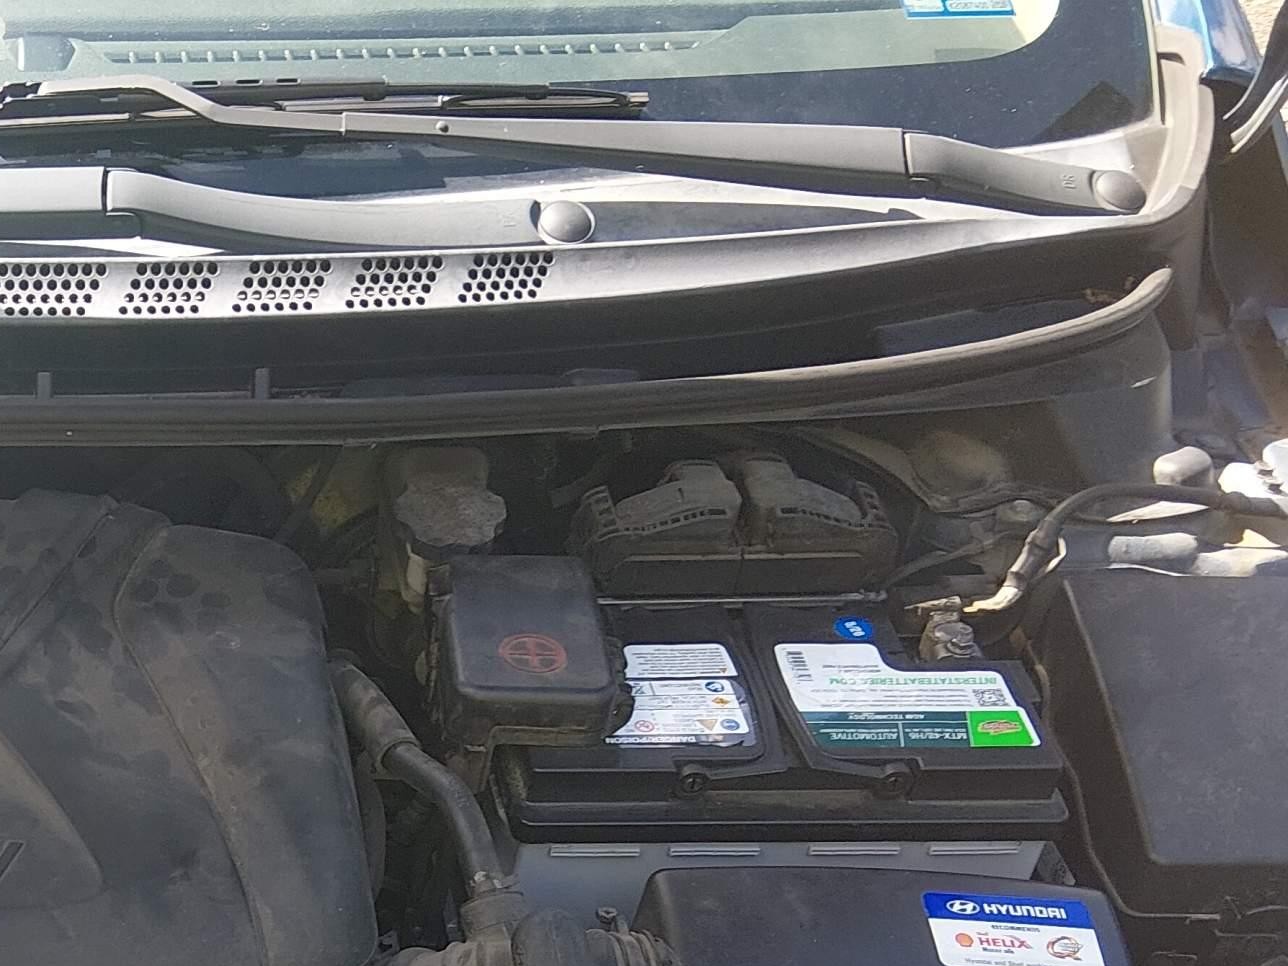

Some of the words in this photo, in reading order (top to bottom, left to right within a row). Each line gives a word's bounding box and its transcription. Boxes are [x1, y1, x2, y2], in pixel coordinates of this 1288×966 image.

[830, 732, 899, 740] AUTOMOTIVE
[983, 903, 1067, 920] HYUNDAI
[978, 935, 1032, 949] HELIX
